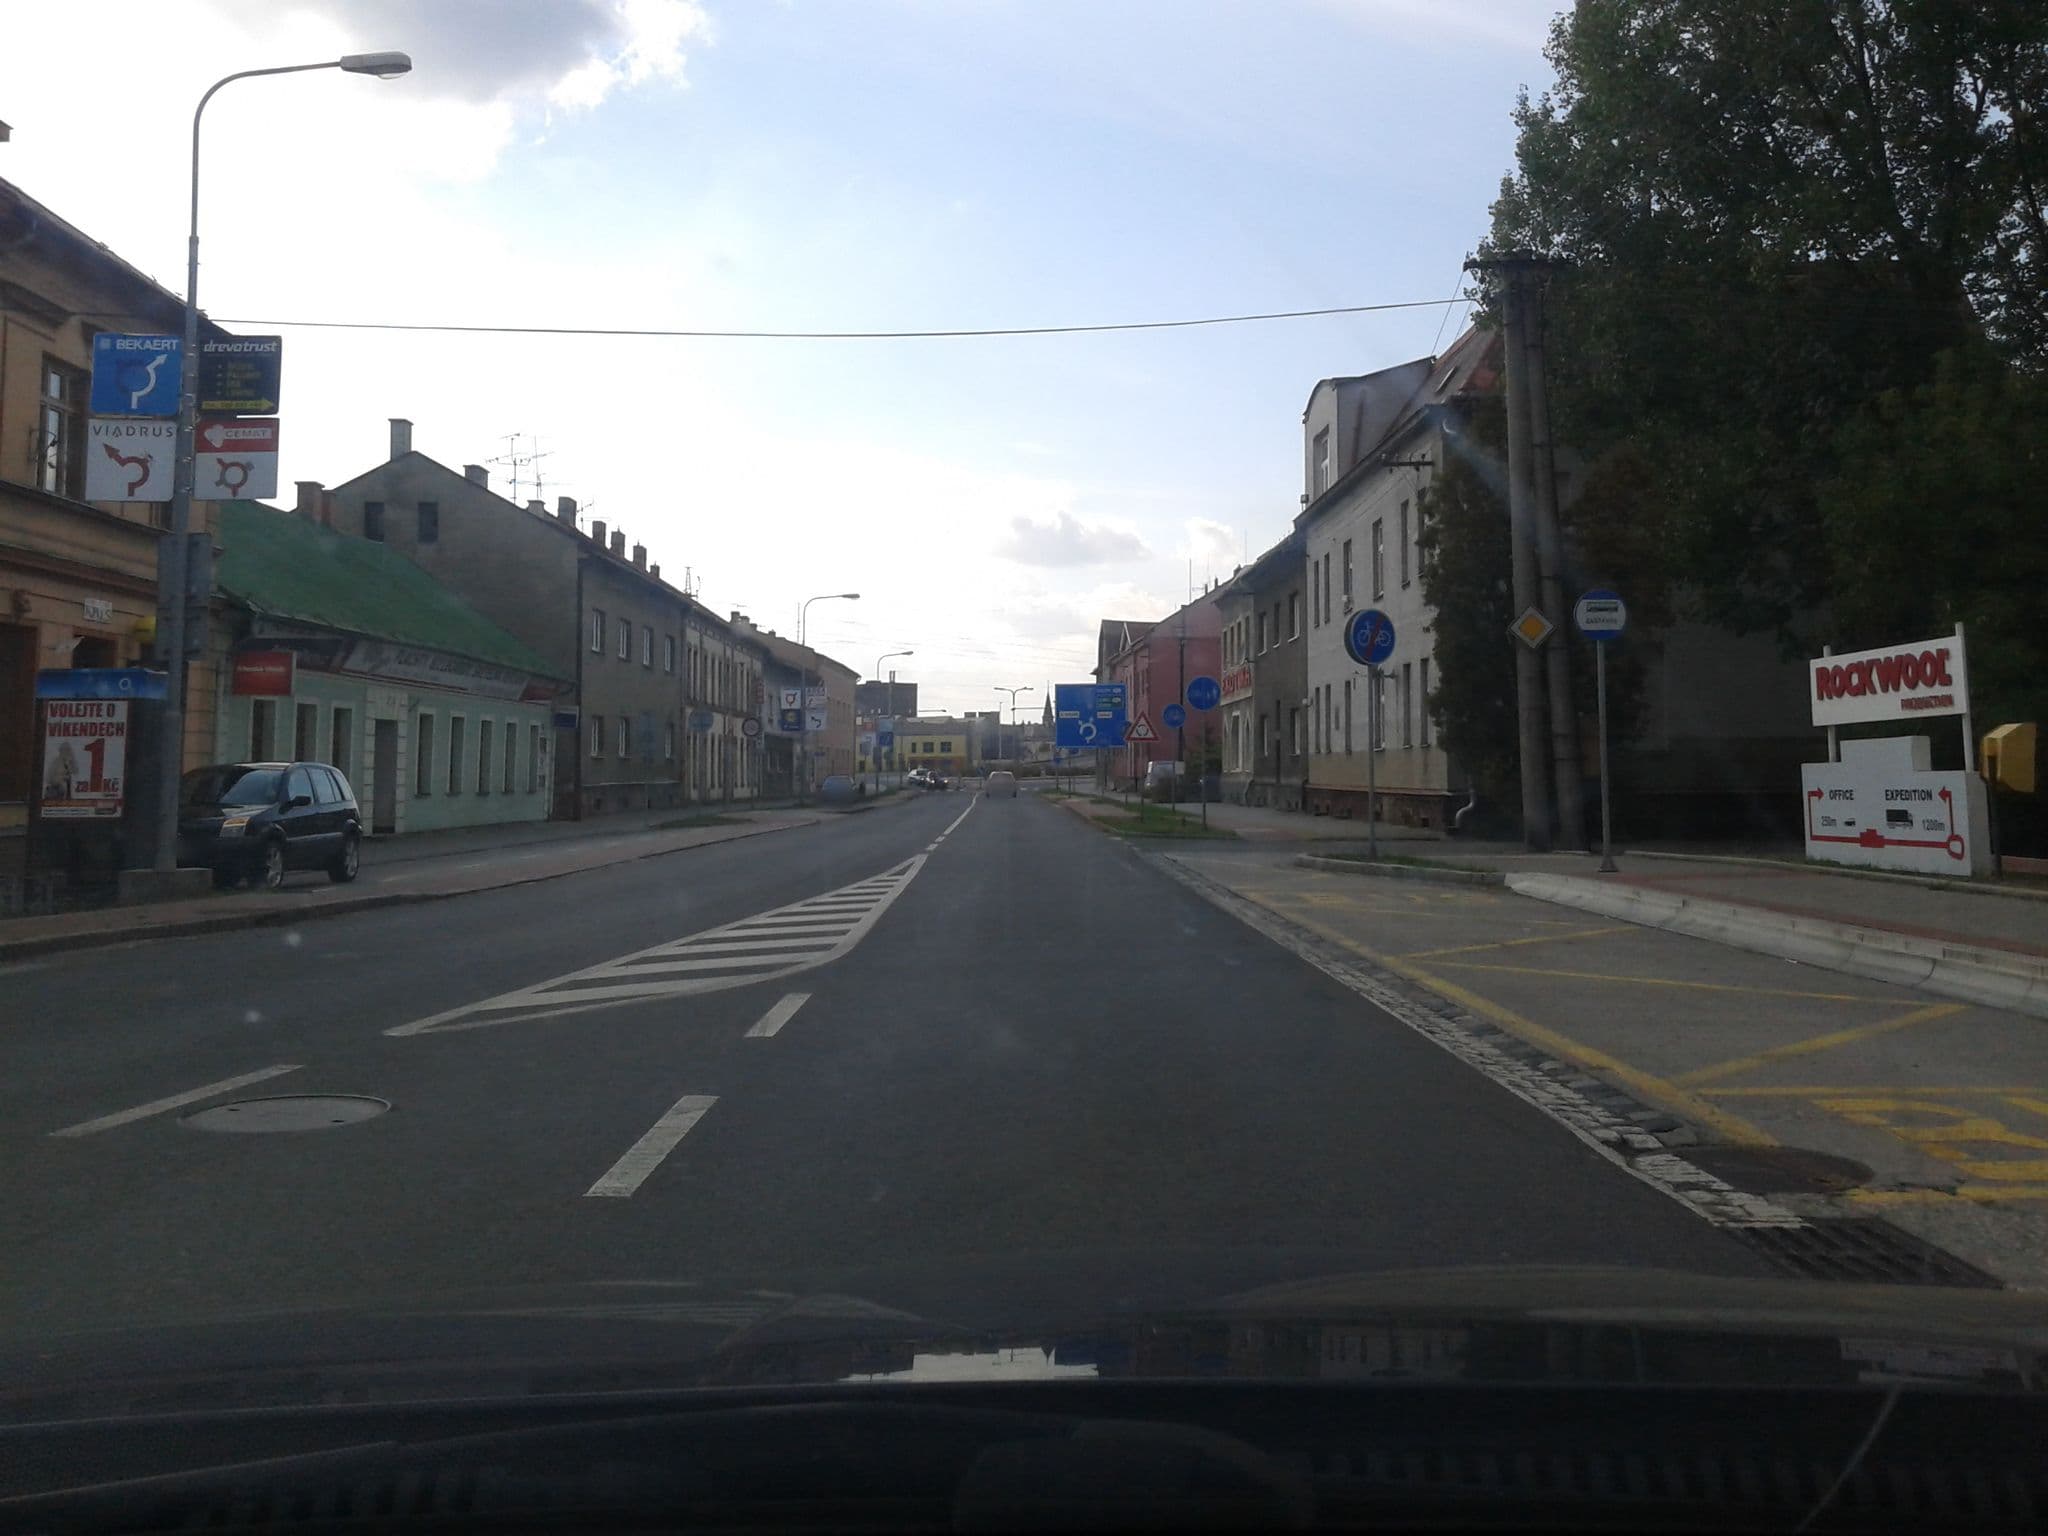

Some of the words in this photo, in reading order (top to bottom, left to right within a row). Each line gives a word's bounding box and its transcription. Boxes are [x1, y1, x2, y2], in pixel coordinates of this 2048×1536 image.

[116, 339, 178, 350] BEKAERT
[204, 340, 277, 352] drevotrust
[93, 425, 173, 437] VIADRUS
[1815, 648, 1952, 700] ROCKWOOL
[49, 703, 103, 718] VOLEJTE
[85, 738, 105, 793] 1
[1829, 789, 1854, 801] OFFICE
[1885, 789, 1932, 801] EXPEDITION
